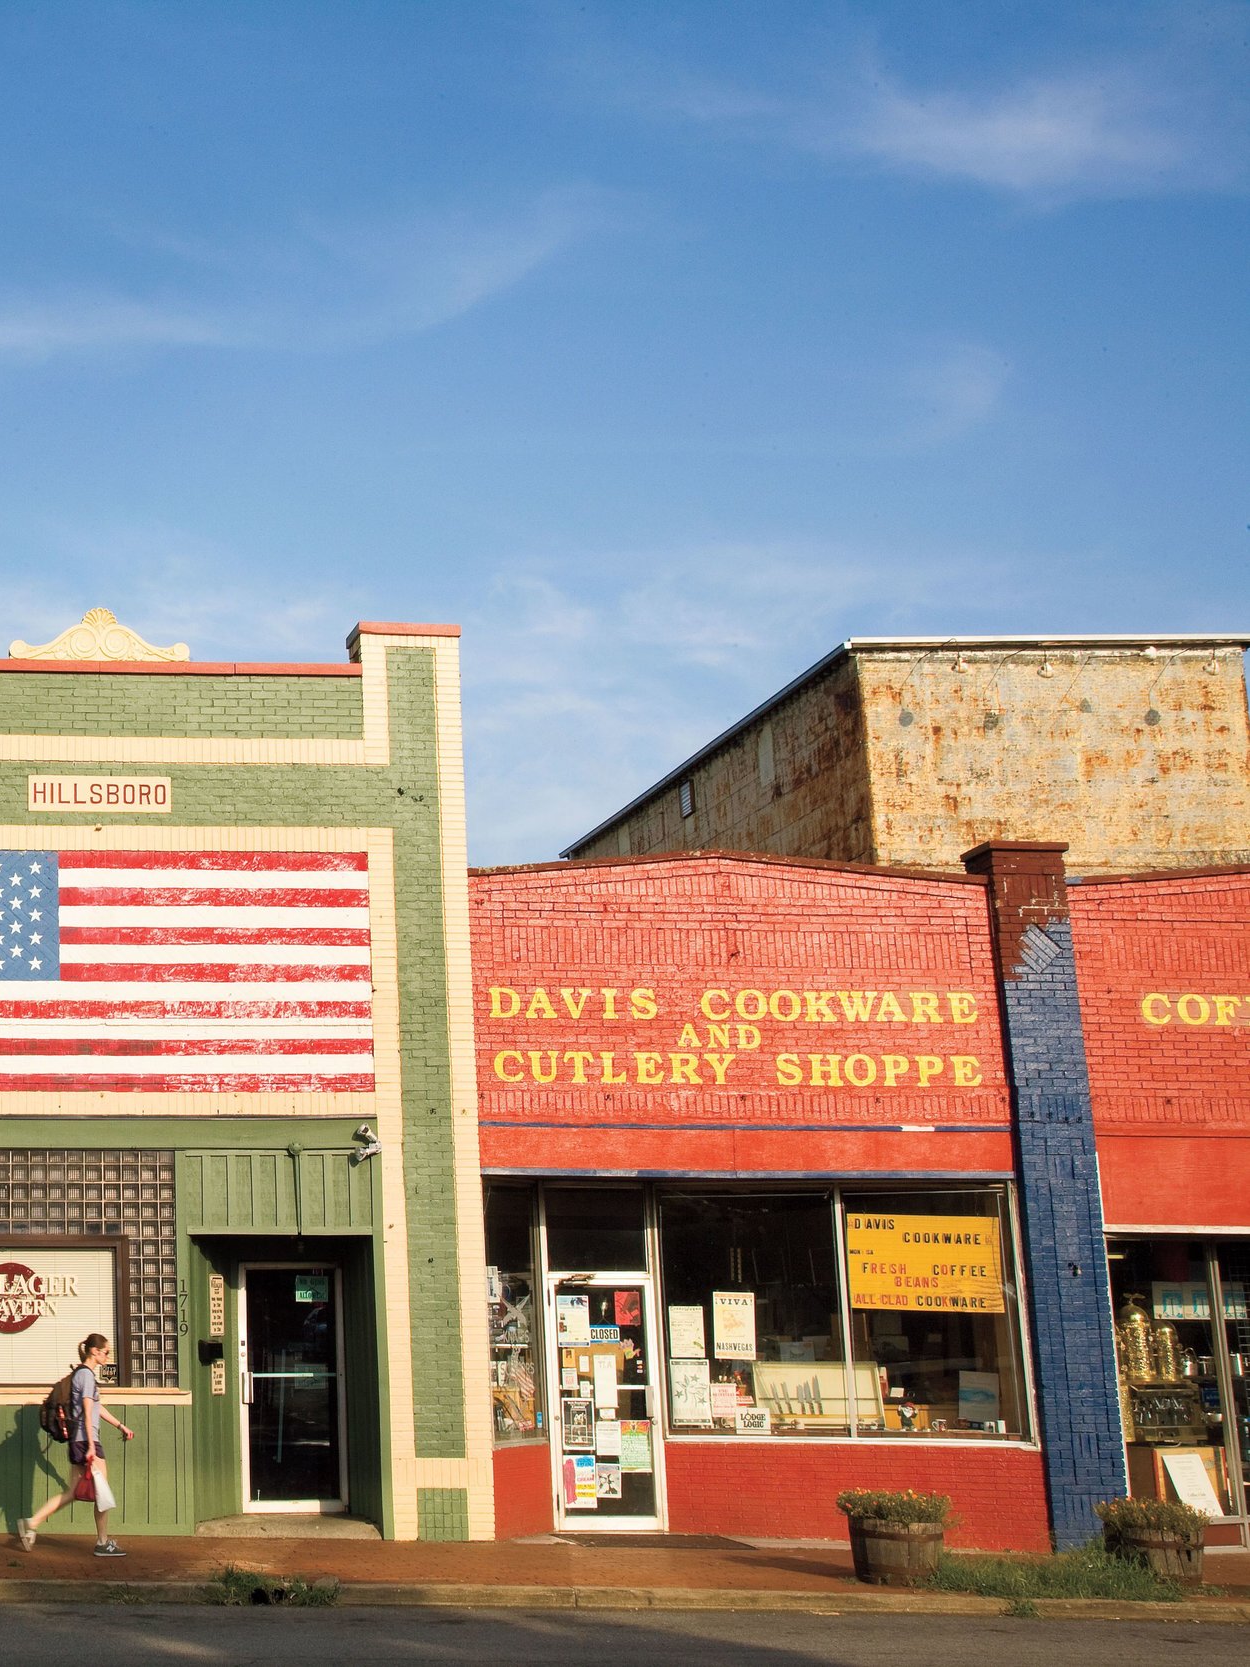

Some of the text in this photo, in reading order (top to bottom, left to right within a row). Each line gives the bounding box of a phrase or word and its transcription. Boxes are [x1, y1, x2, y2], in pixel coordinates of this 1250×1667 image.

[33, 782, 167, 805] HILLSBORO
[488, 987, 979, 1024] DAVIS COOKWARE
[1141, 992, 1250, 1026] COF
[677, 1023, 762, 1050] AND
[493, 1050, 984, 1088] CUTLERY SHOPPE
[854, 1218, 895, 1230] DAVIS
[903, 1232, 982, 1245] COOKWARE
[862, 1262, 987, 1277] FRESH COFFEE
[894, 1277, 939, 1288] BEANS
[179, 1279, 189, 1337] 1719
[916, 1295, 987, 1309] COOKWARE
[590, 1328, 619, 1340] CLOSED
[716, 1342, 753, 1352] NASHVEGAS
[740, 1412, 767, 1421] LODGE
[743, 1420, 765, 1428] LOGIC
